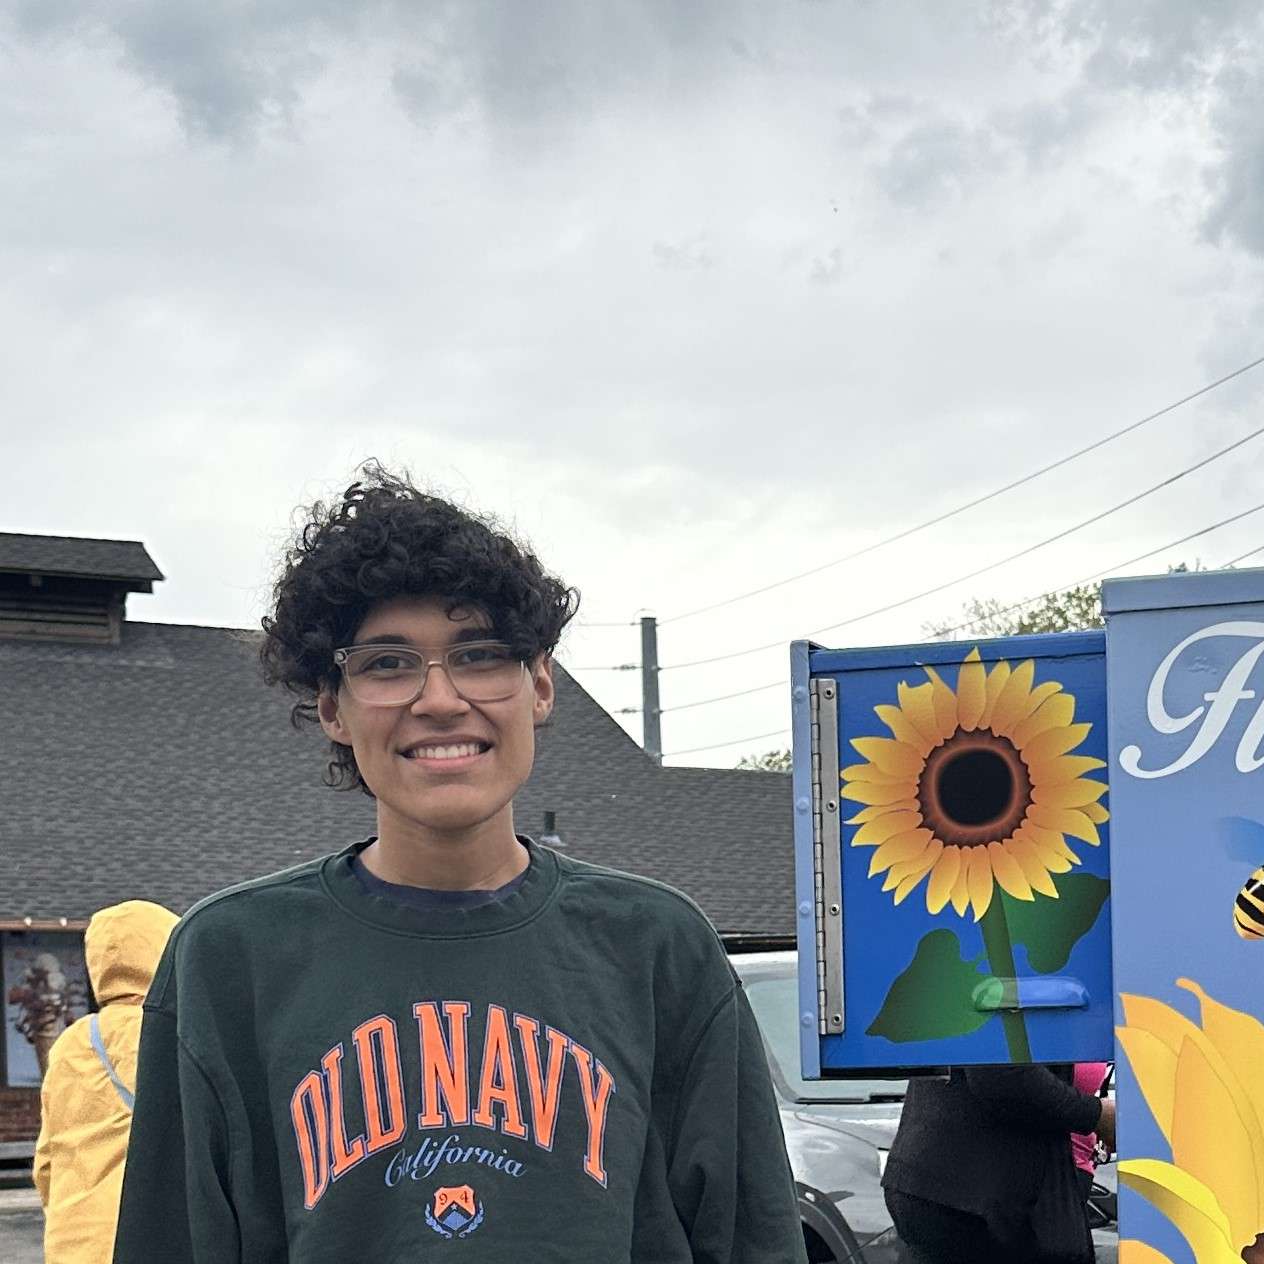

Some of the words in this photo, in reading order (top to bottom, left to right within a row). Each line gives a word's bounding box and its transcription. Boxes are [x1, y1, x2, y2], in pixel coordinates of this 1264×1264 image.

[290, 1013, 407, 1211] OLD
[412, 1000, 616, 1189] NAVY
[384, 1134, 528, 1188] California
